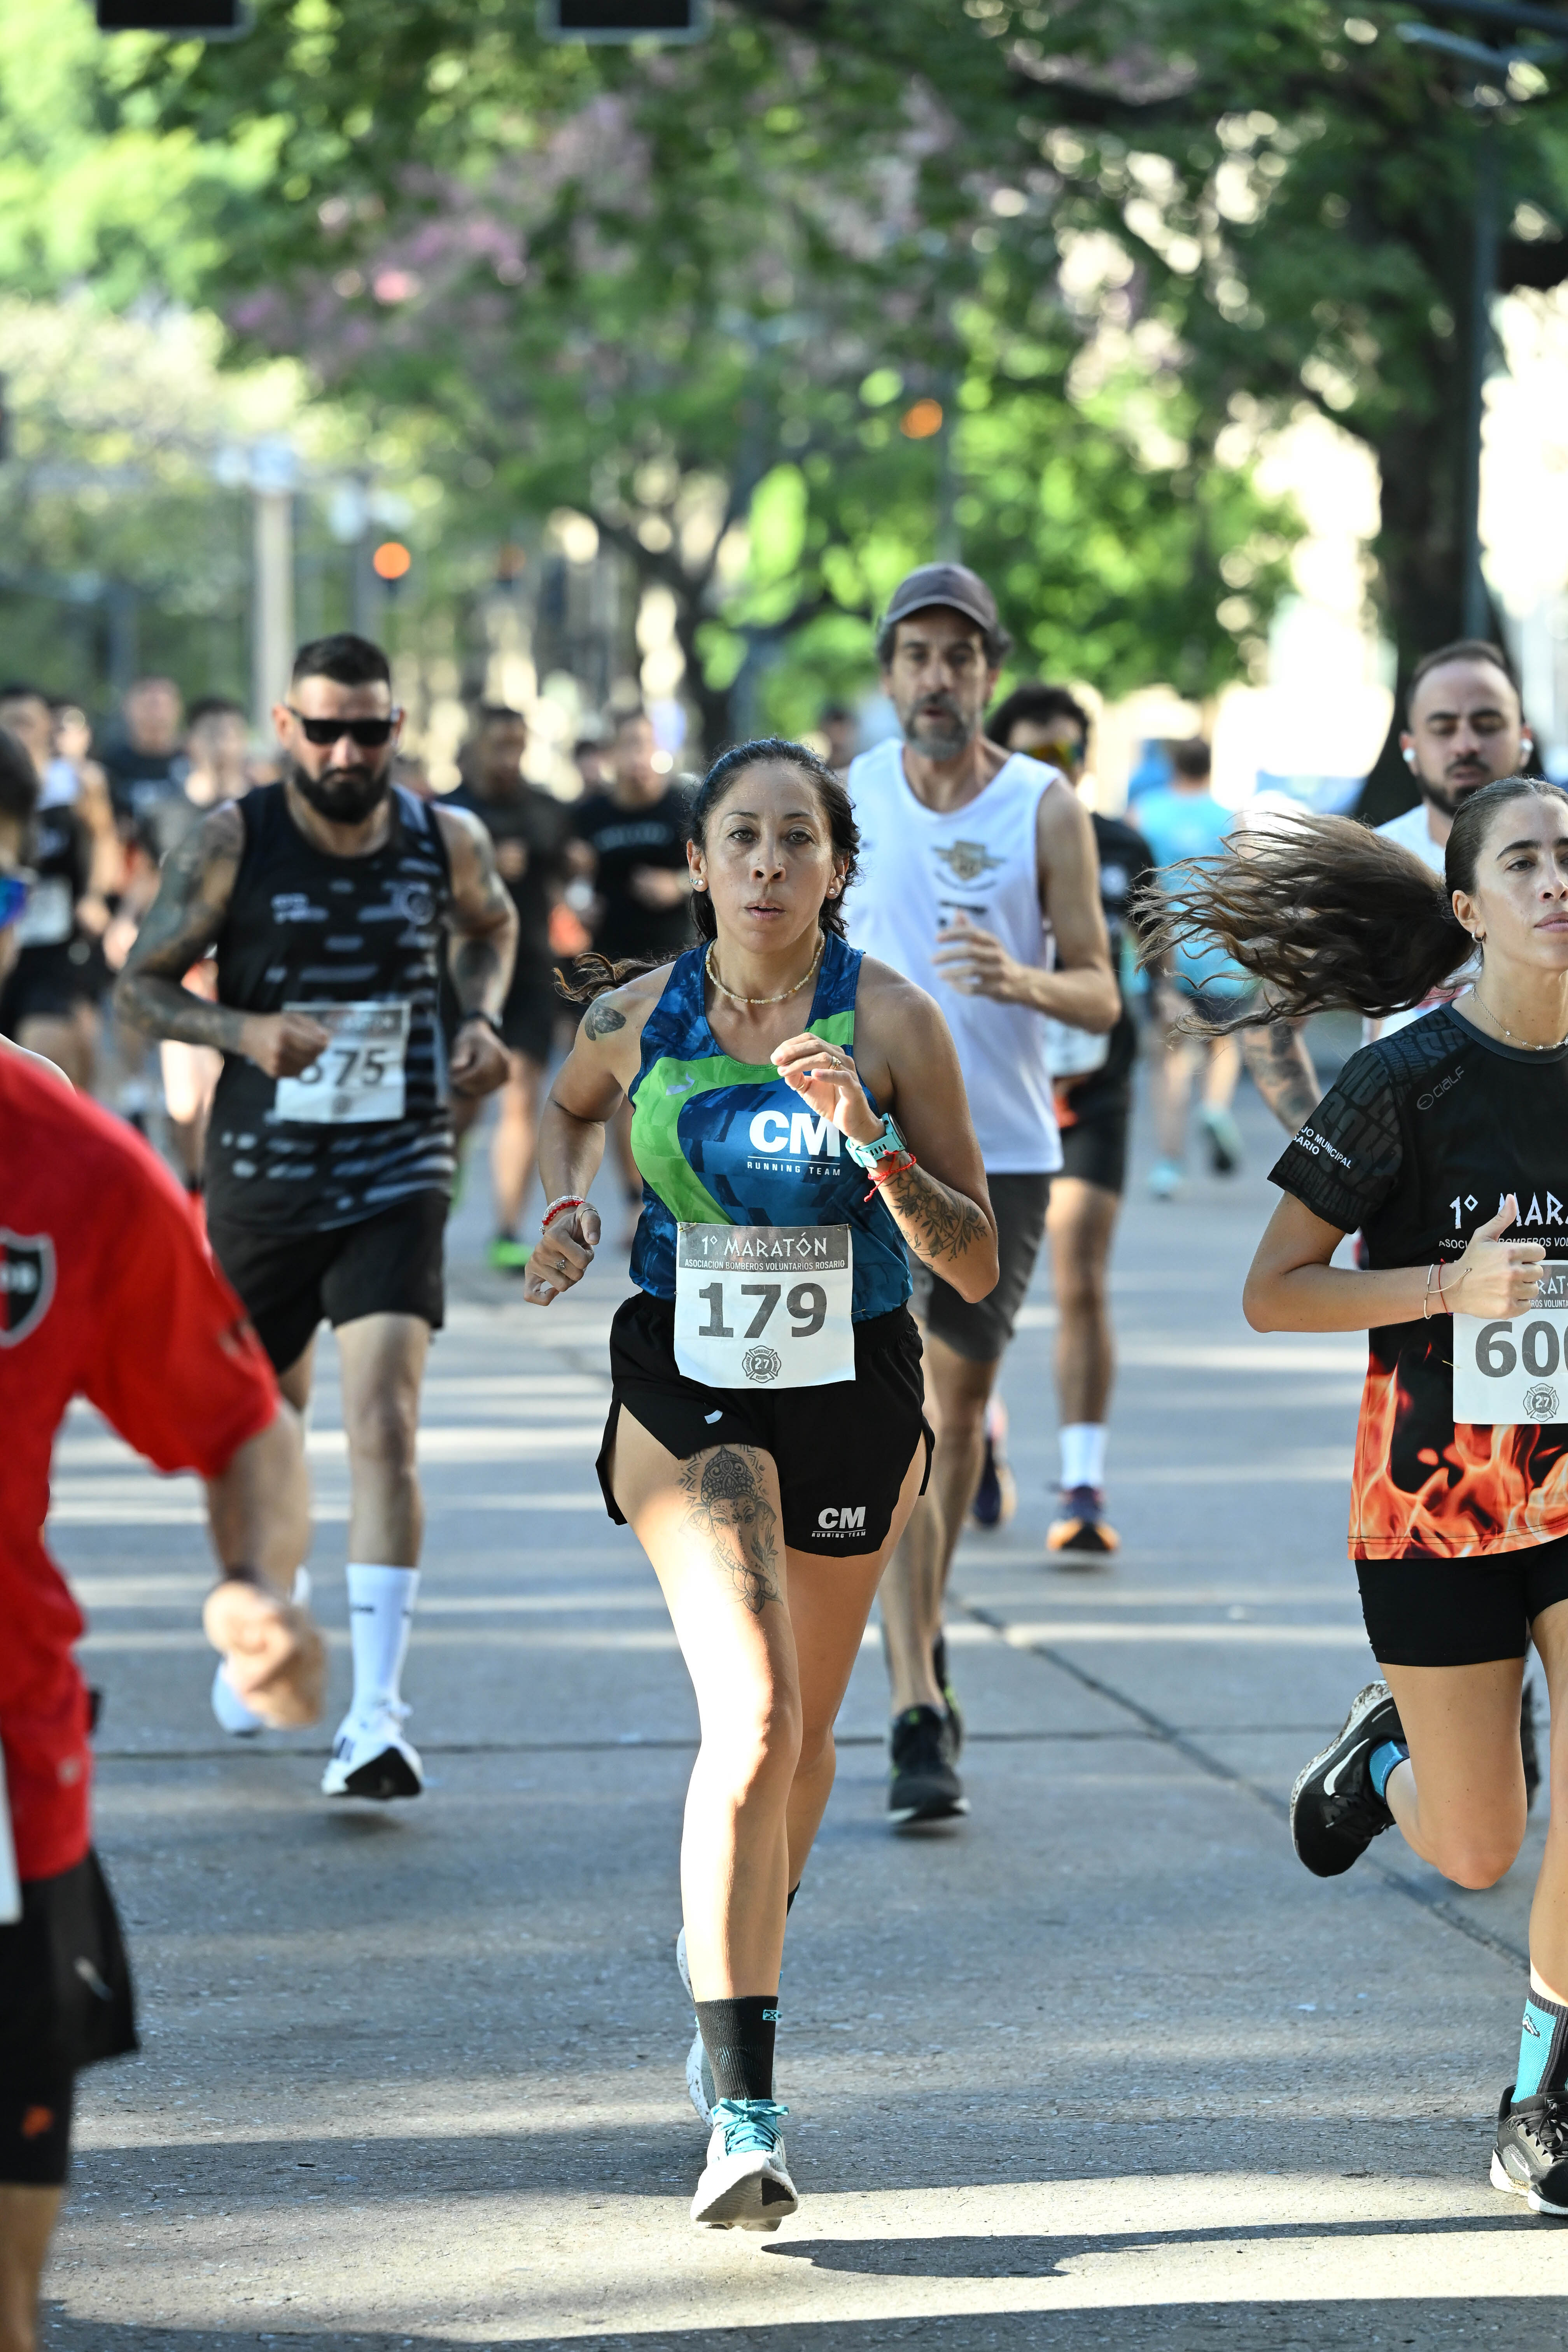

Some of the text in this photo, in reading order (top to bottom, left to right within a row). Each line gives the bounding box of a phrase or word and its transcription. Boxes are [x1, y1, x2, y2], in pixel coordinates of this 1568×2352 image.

[749, 1110, 840, 1157] CM
[1300, 1126, 1351, 1169] JO MUNICIPAL
[747, 1161, 841, 1176] RUNNING TEAM
[724, 1232, 827, 1257] MARATÓN
[1439, 1239, 1468, 1249] ASOCI
[685, 1258, 845, 1270] ASOCIACIÓN BOMBEROS VOLUNTARIOS ROSARIO
[1536, 1276, 1568, 1295] RAT
[699, 1283, 827, 1338] 179
[1475, 1321, 1568, 1378] 60
[755, 1357, 770, 1370] 27
[1536, 1395, 1550, 1408] 27
[818, 1507, 866, 1529] CM
